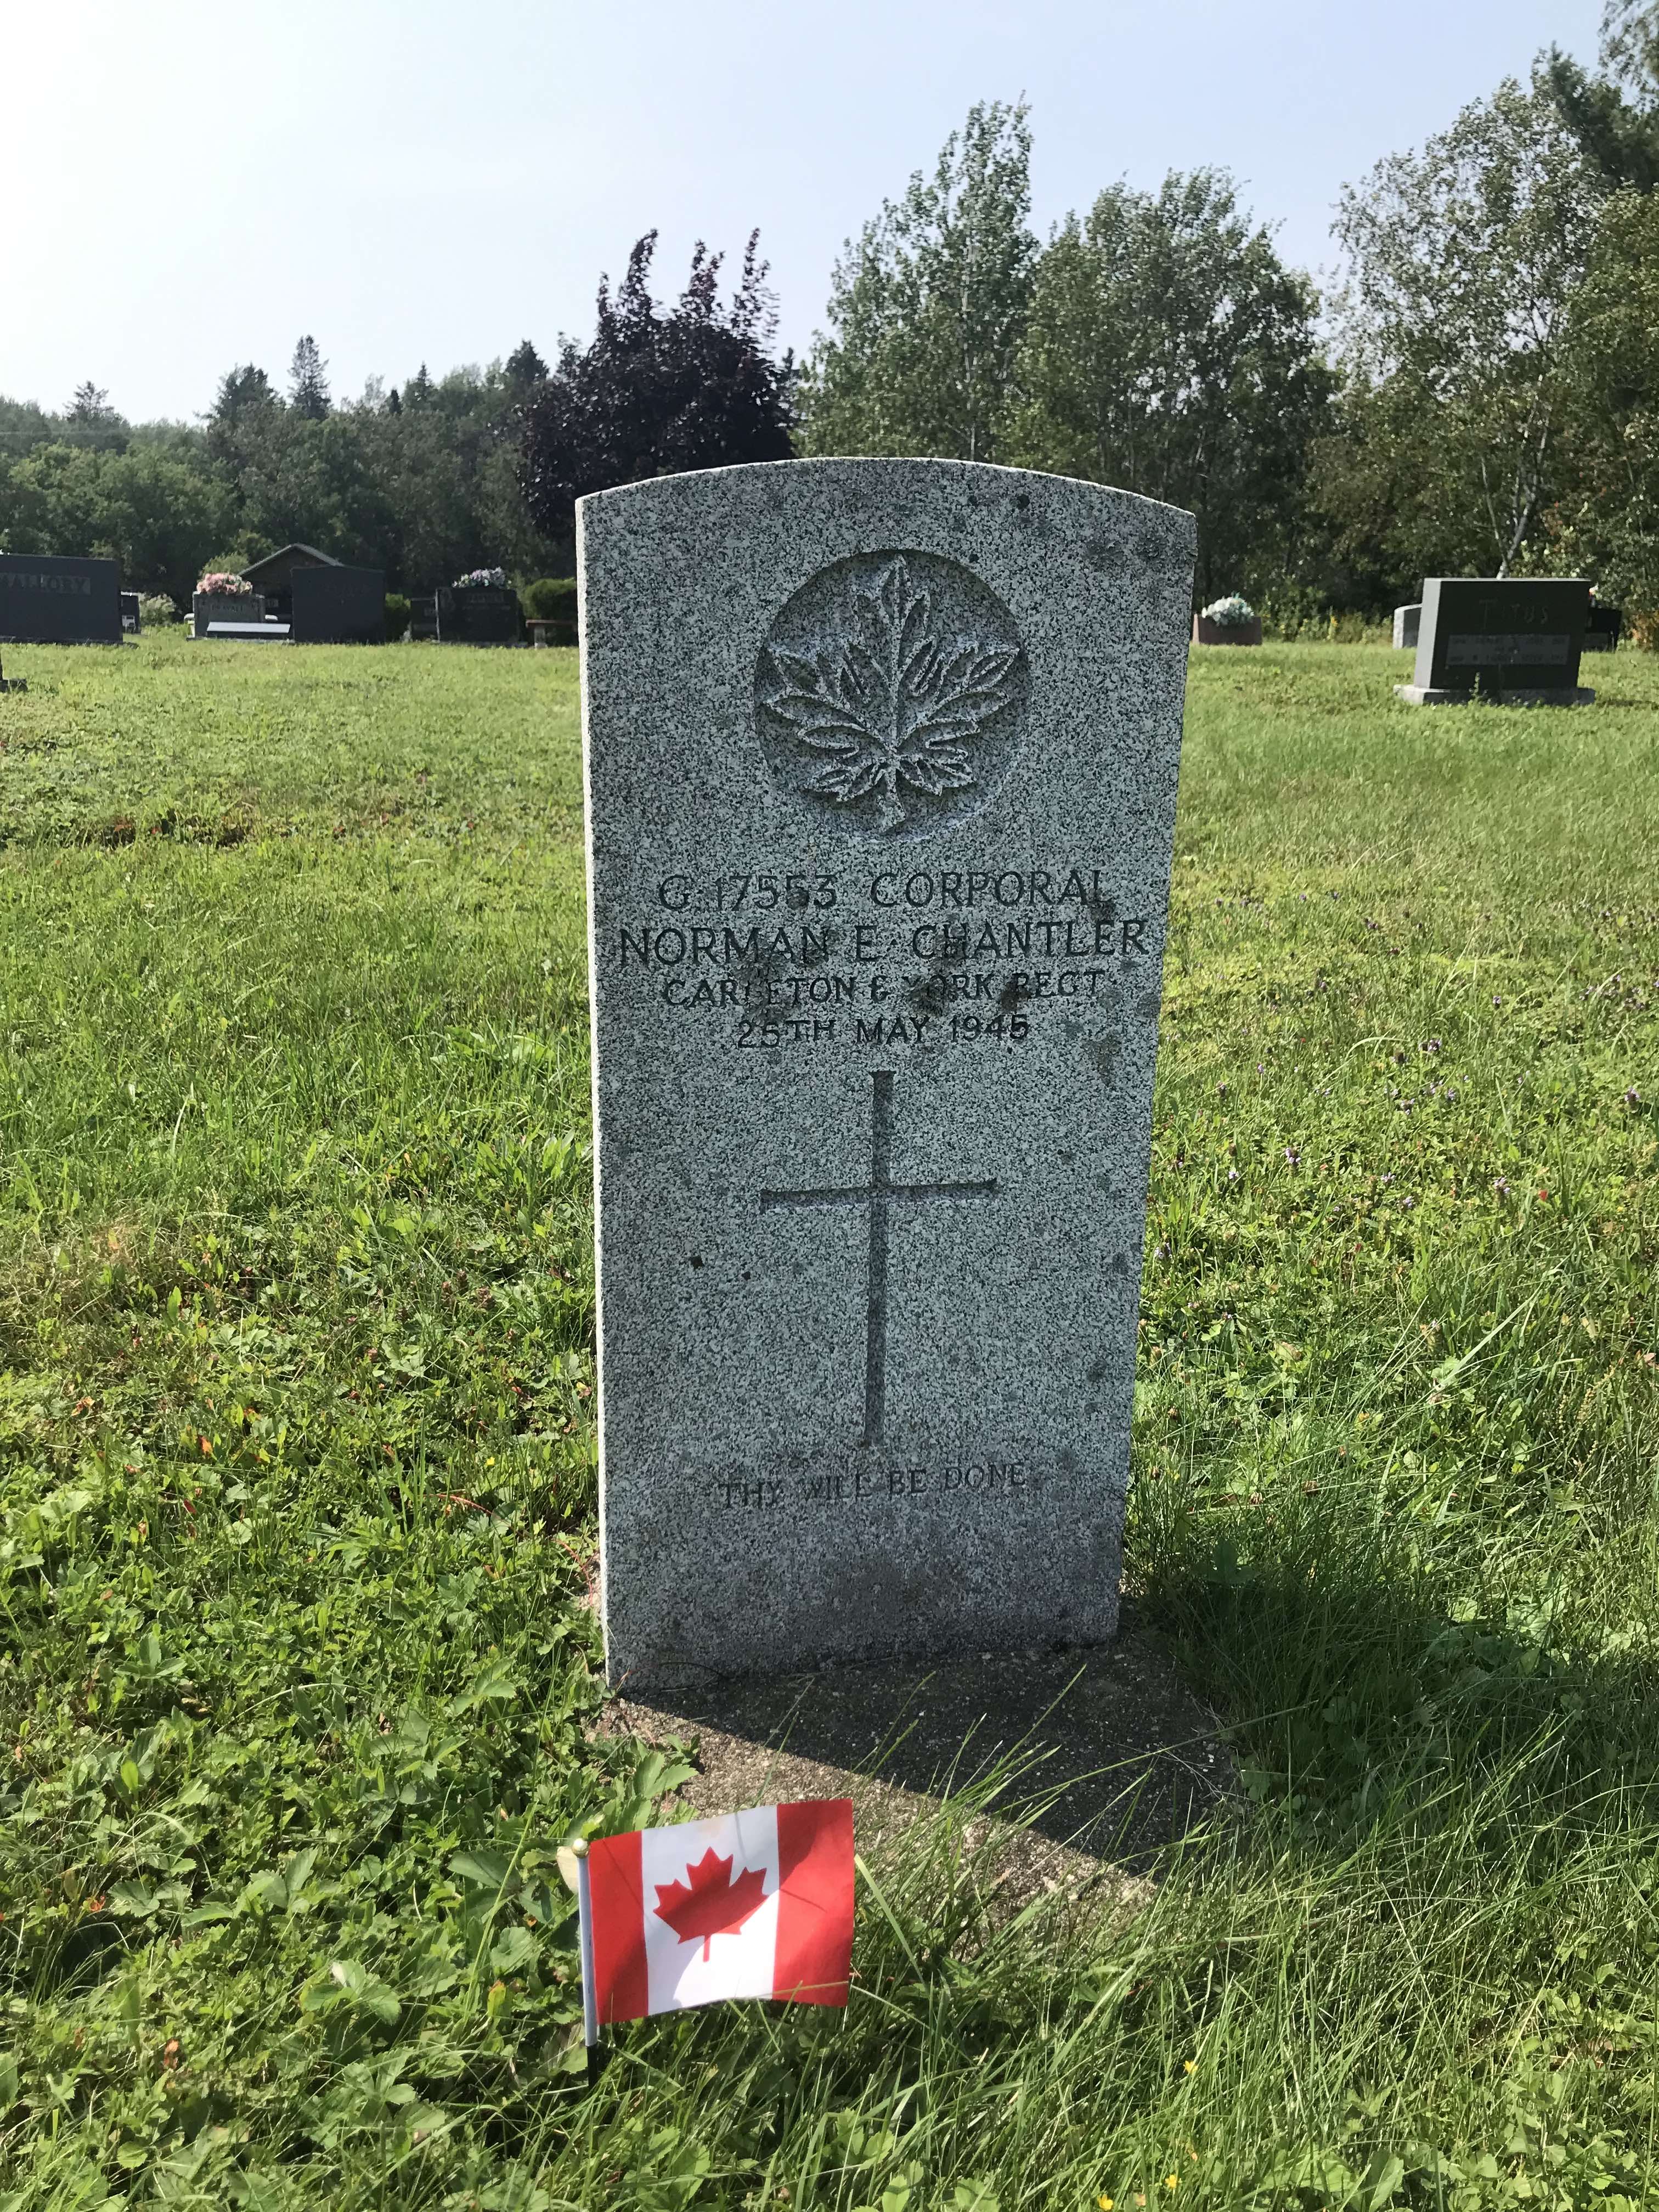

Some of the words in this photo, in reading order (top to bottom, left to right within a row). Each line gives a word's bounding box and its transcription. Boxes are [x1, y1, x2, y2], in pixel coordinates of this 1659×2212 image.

[871, 869, 1105, 907] CORPORAL
[619, 926, 832, 966] NORMAN
[912, 919, 1149, 960] CHANTLER
[664, 977, 856, 1007] CARLETON
[870, 974, 892, 1003] &
[738, 1020, 836, 1047] 25TH
[856, 1015, 929, 1045] MAY
[949, 1014, 1029, 1041] 1945
[718, 1481, 781, 1508] THY
[888, 1468, 927, 1498] BE
[941, 1462, 1027, 1492] DONE
